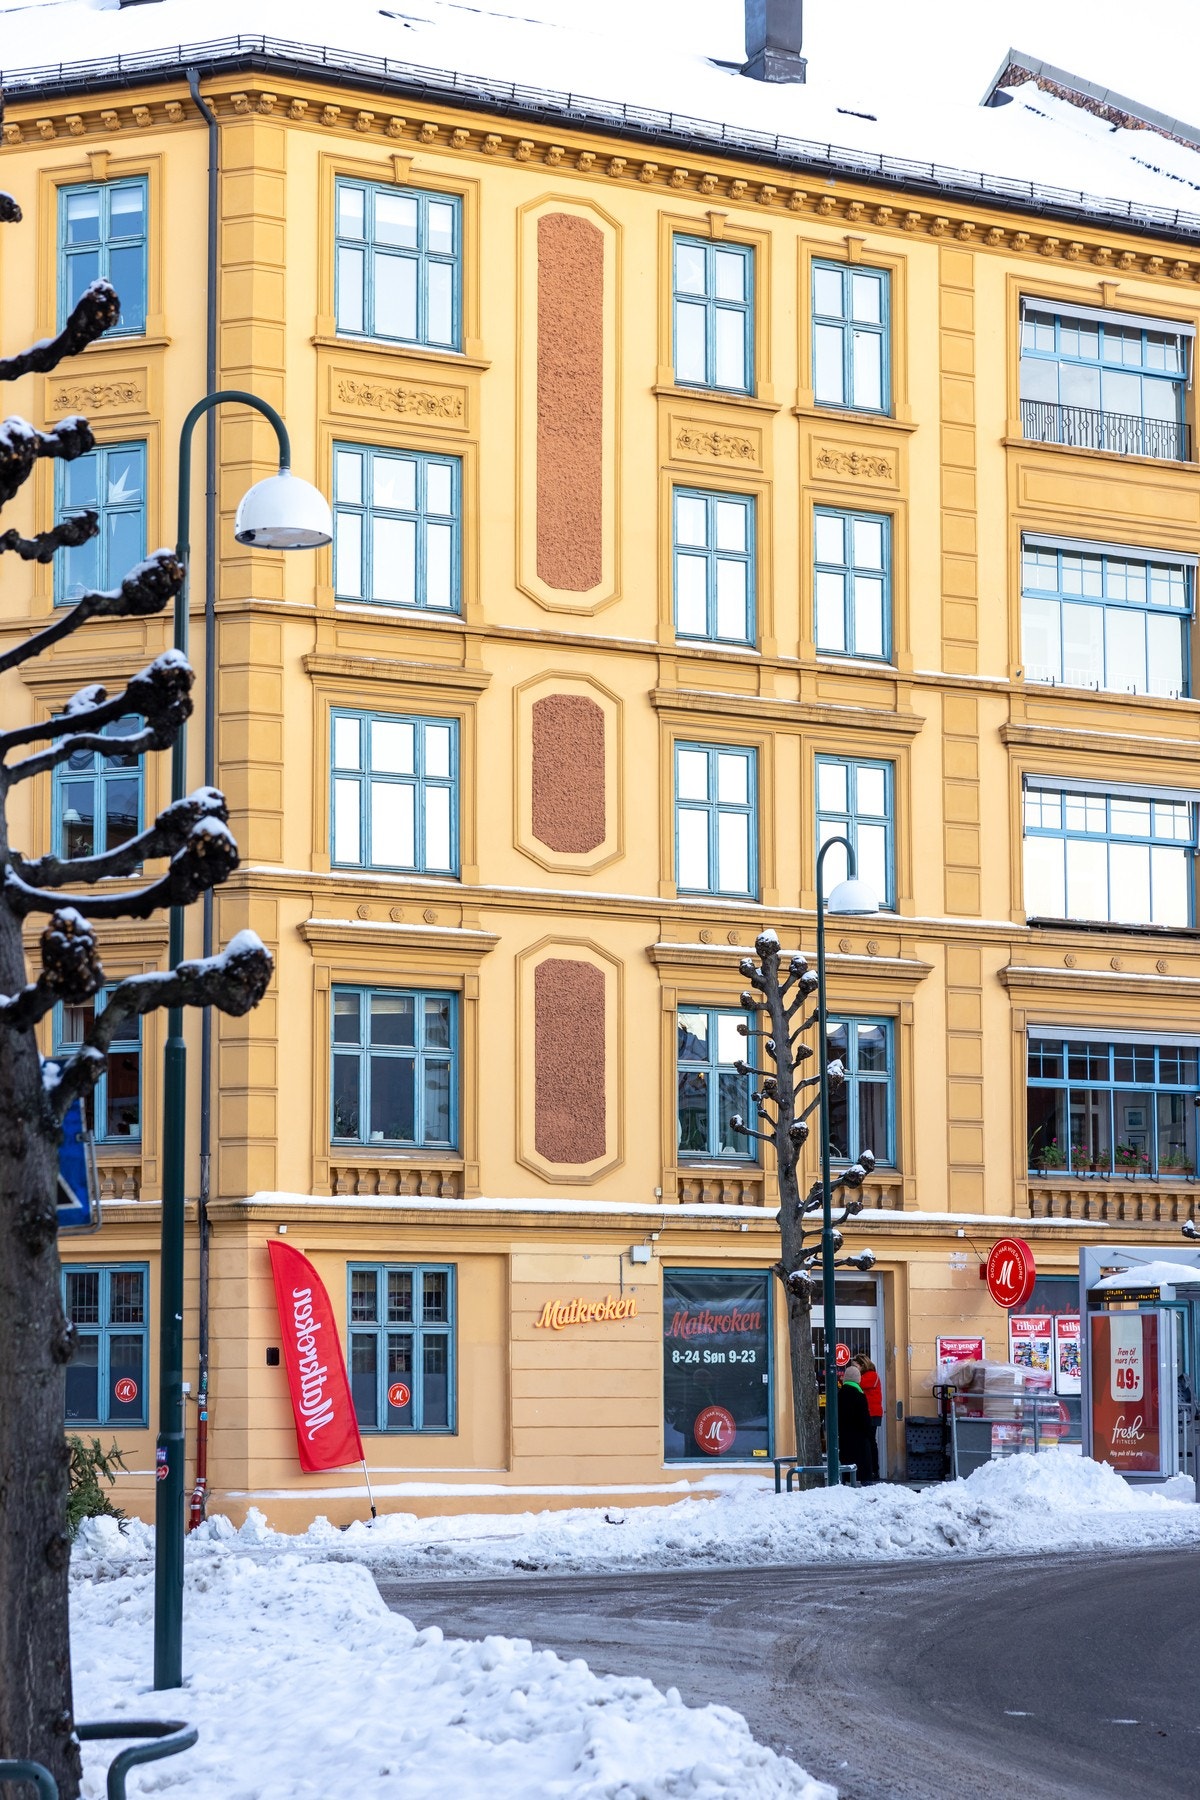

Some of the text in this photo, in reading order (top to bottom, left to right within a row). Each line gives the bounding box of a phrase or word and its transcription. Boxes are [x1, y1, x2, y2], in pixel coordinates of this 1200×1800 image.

[998, 1246, 1008, 1254] HAR
[996, 1260, 1015, 1289] M
[535, 1295, 638, 1330] Matkroken
[665, 1307, 762, 1339] Matkroken
[1016, 1321, 1046, 1331] tilbud!
[672, 1350, 756, 1364] 8-24 Søn 9-23
[120, 1385, 131, 1397] M
[393, 1390, 404, 1401] M
[705, 1420, 724, 1441] M
[1111, 1415, 1145, 1444] fresh
